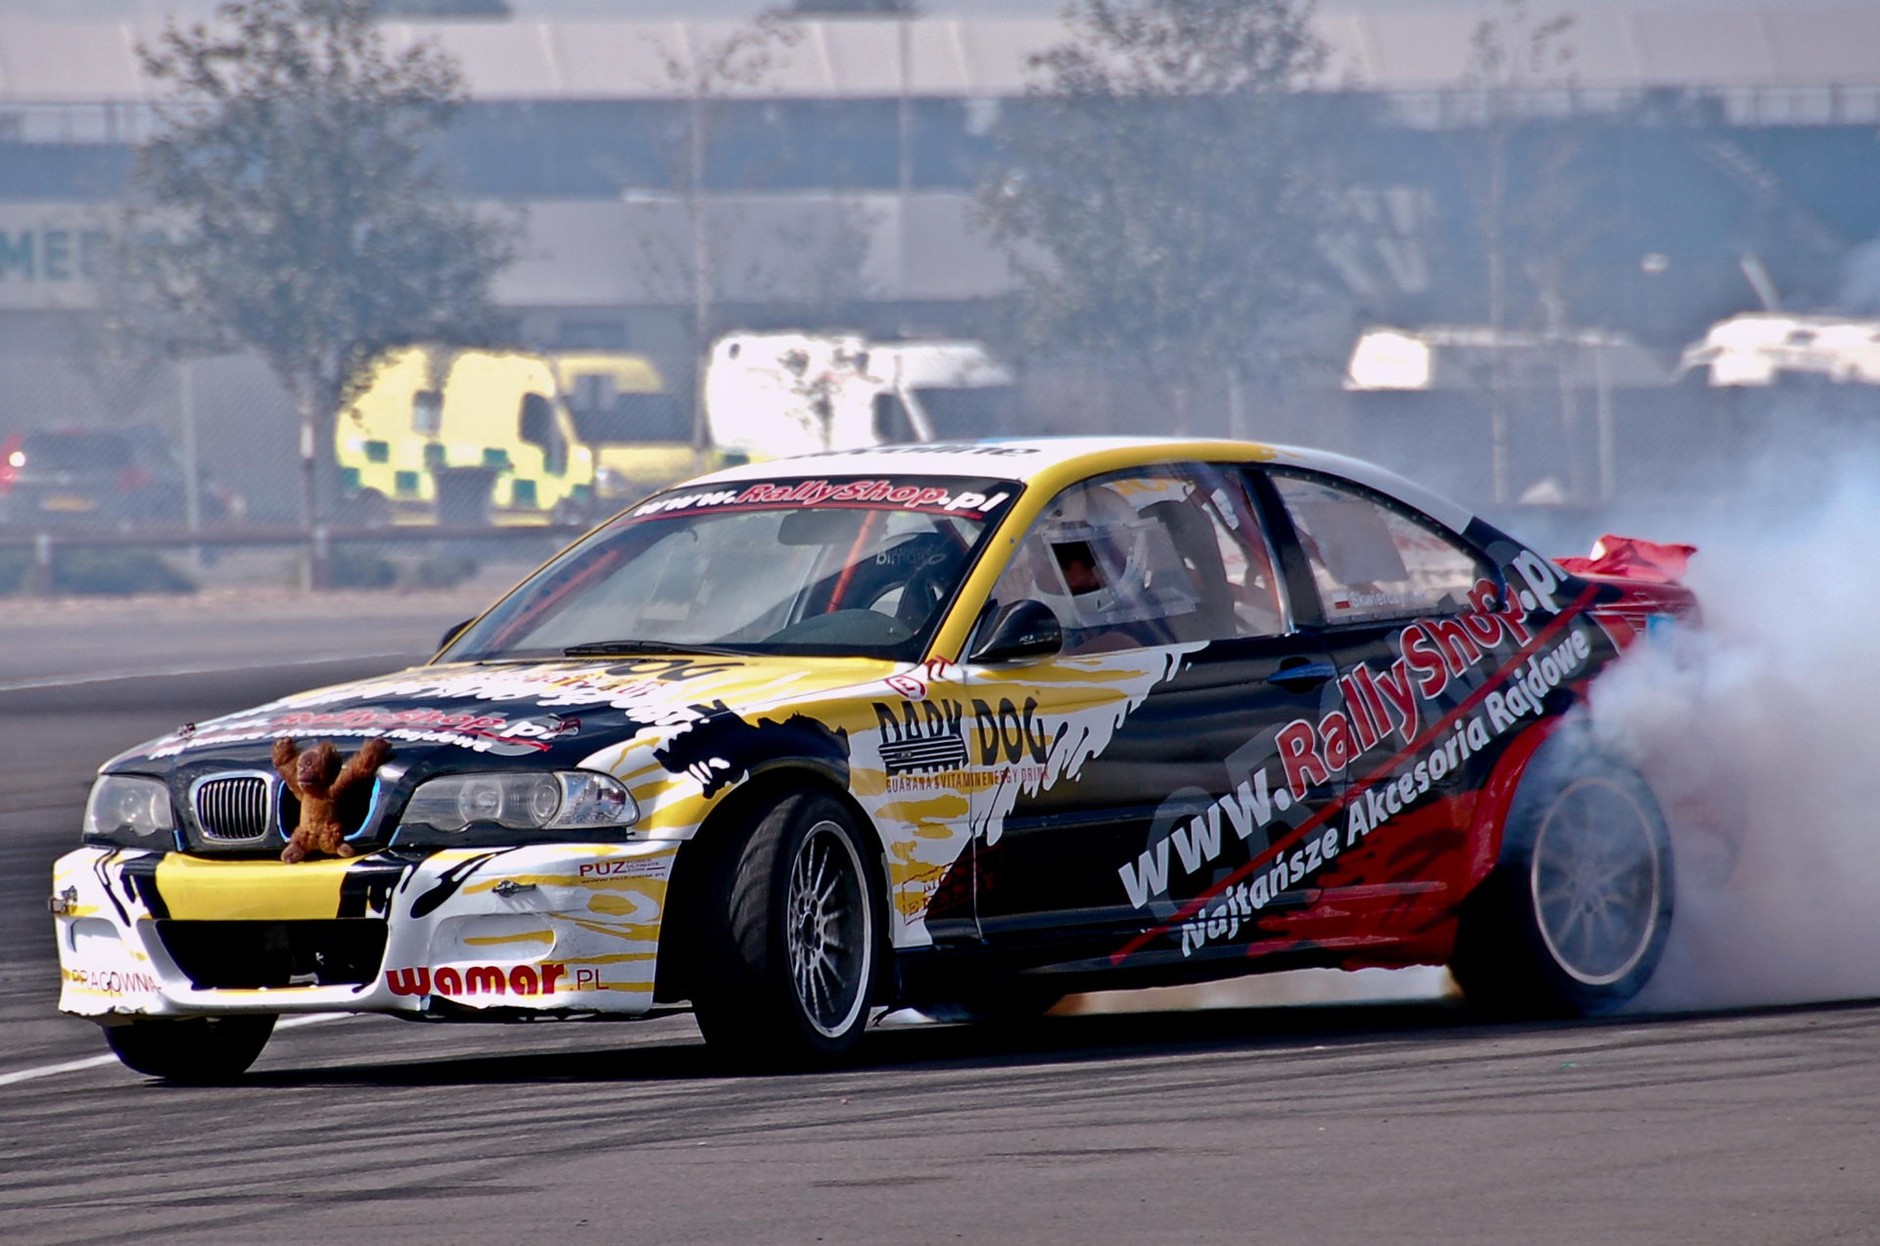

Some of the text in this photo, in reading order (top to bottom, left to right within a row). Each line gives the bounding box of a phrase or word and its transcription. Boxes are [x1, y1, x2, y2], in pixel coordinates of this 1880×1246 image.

[634, 480, 1008, 515] www.RallyShop.pl
[971, 696, 1048, 766] DOG
[1346, 714, 1487, 848] Akcesoria
[1484, 628, 1591, 736] Rajdowe
[579, 860, 628, 877] PUZ
[386, 963, 566, 996] wamar
